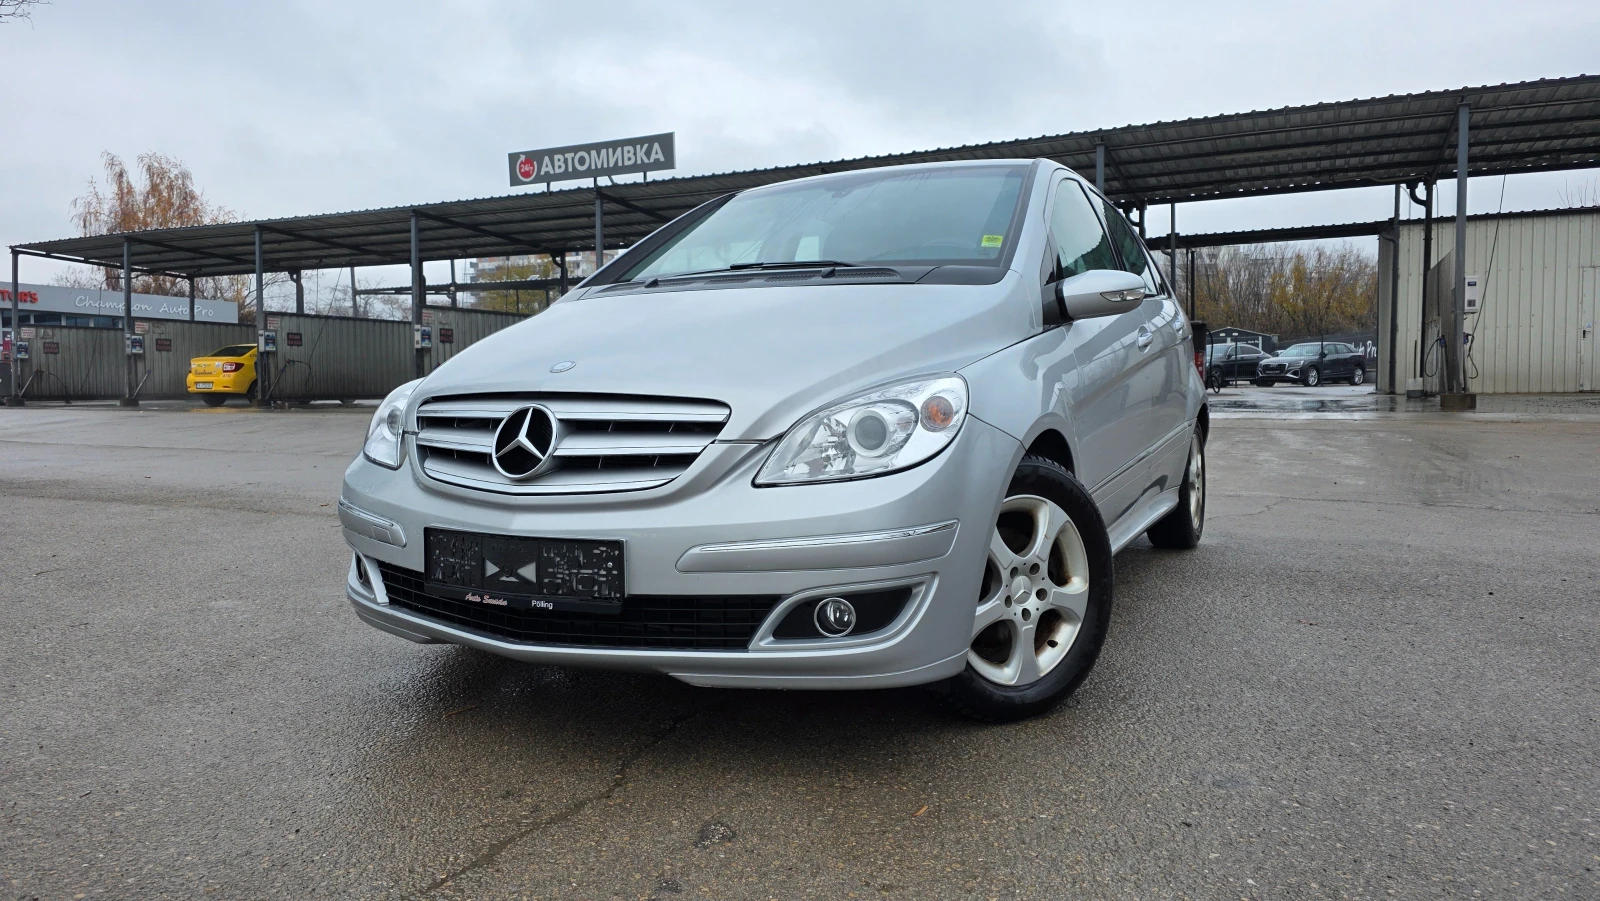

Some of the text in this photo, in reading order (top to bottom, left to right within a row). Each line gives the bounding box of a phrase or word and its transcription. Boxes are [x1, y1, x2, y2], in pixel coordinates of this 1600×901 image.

[520, 142, 665, 176] 24/7 АВТОМИВКА
[75, 295, 214, 317] Champon Auto Pro
[531, 600, 553, 610] Pölling
